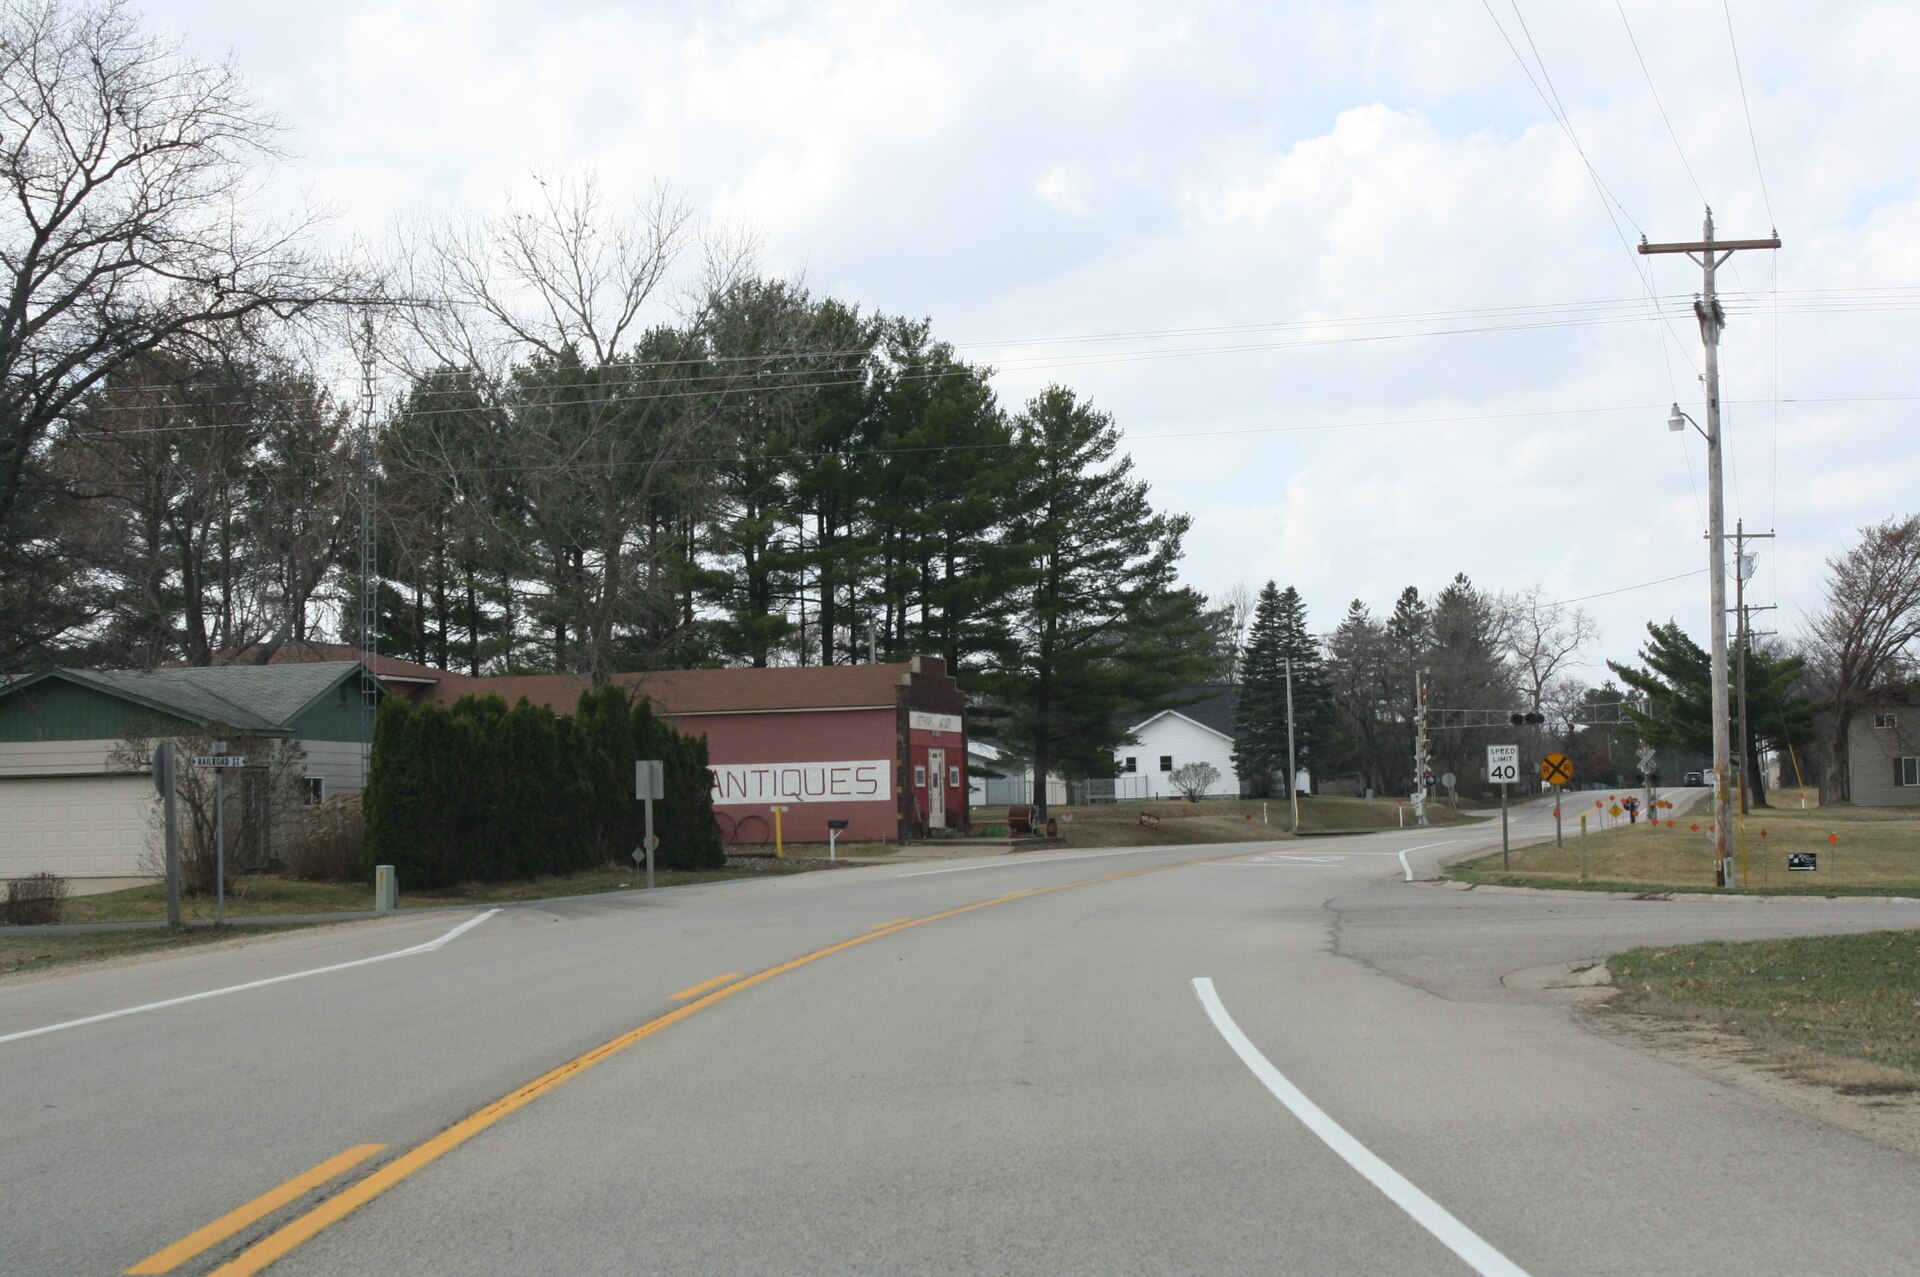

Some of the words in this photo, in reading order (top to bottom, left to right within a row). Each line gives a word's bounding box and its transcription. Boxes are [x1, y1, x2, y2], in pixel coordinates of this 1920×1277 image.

[198, 757, 229, 765] RAILROAD
[1491, 765, 1516, 779] 40
[1543, 765, 1549, 773] R
[1563, 764, 1570, 772] R
[712, 766, 878, 802] ANTIQUES
